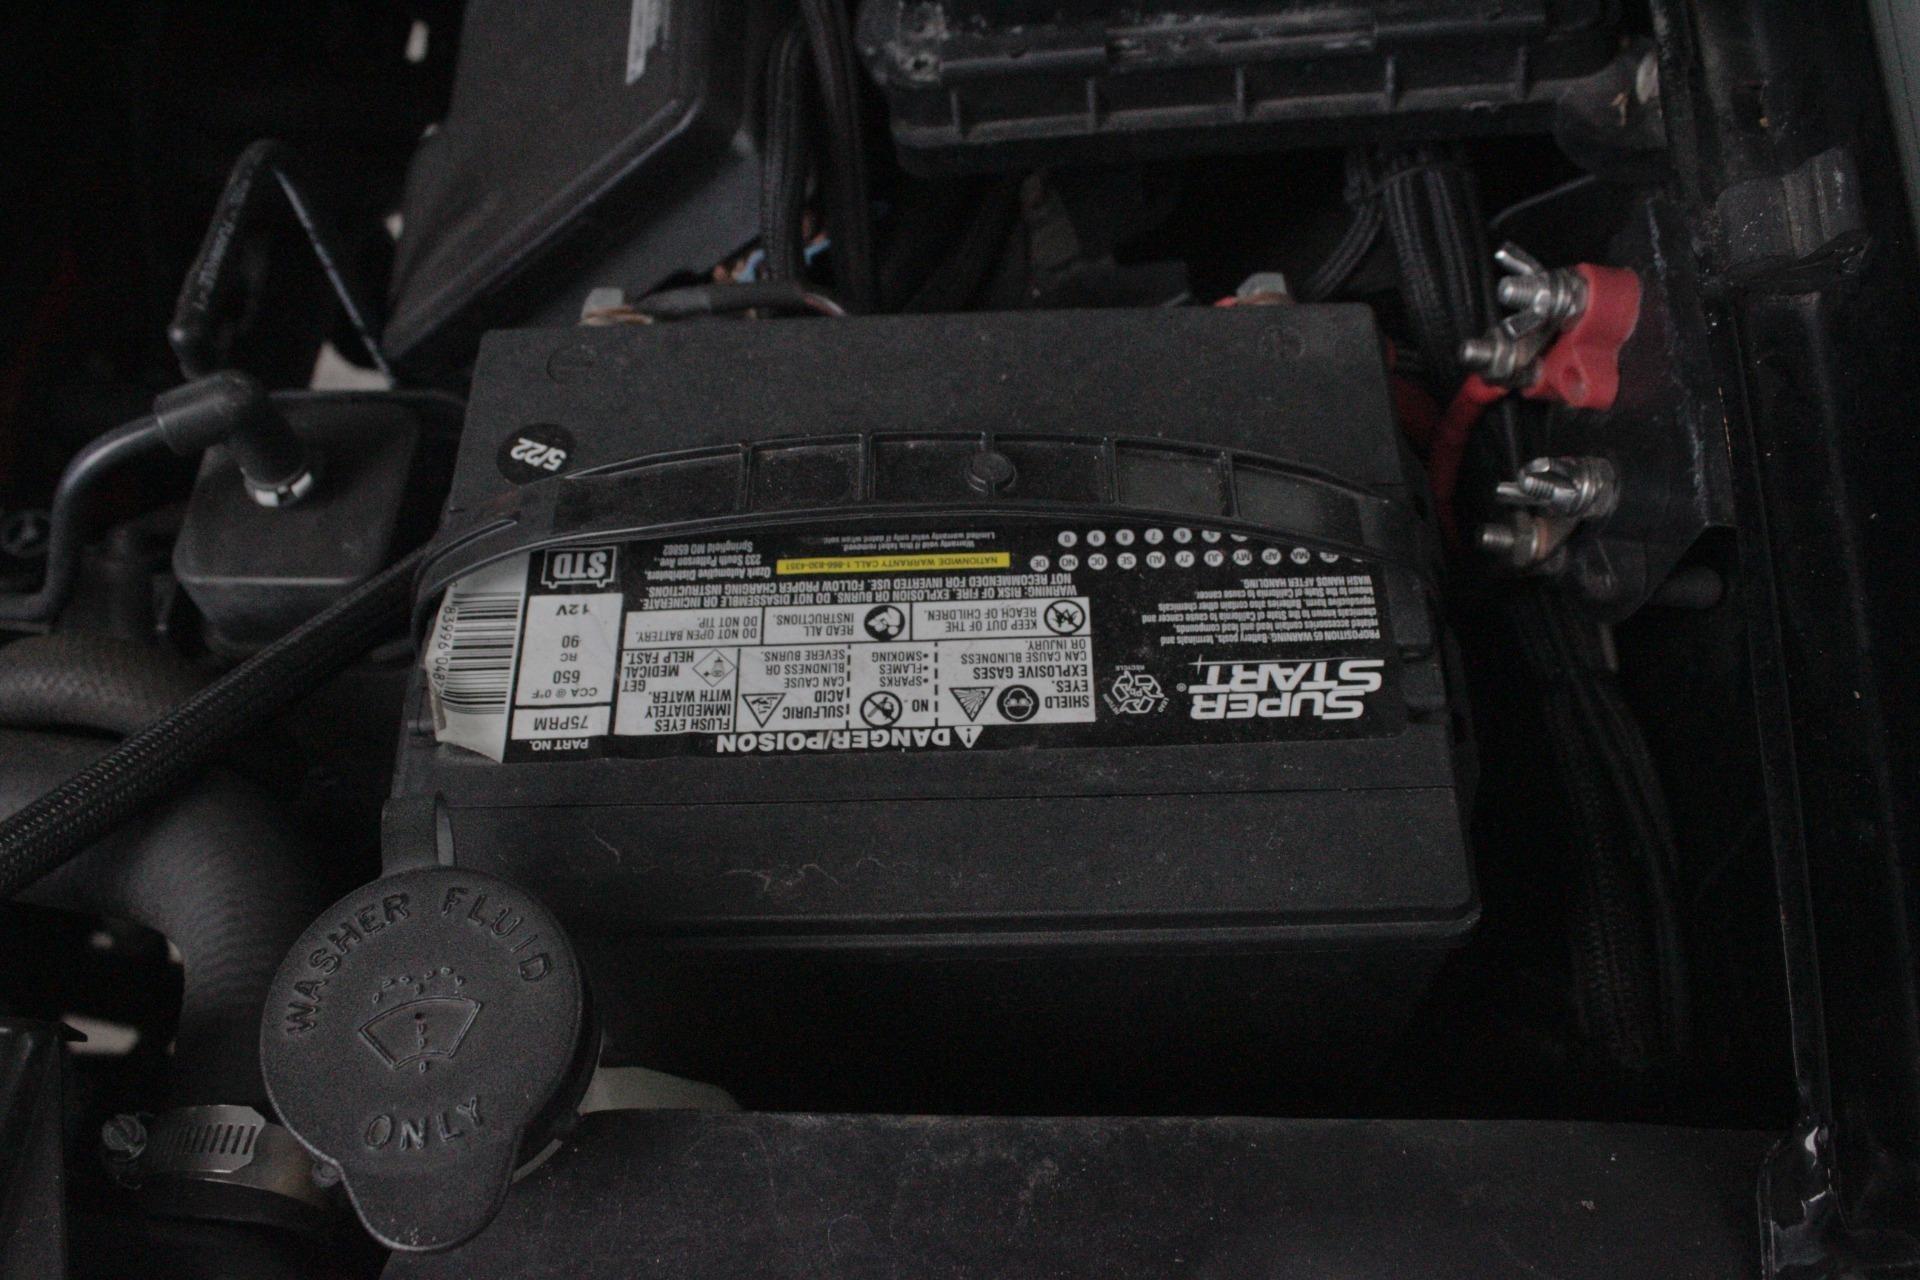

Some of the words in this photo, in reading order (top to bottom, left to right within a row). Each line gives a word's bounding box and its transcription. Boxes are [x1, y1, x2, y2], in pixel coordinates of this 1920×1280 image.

[510, 437, 567, 471] 5/22
[690, 544, 705, 554] MO
[707, 540, 753, 554] Springfield
[553, 552, 607, 579] STD
[677, 556, 717, 568] Patterson
[719, 554, 744, 567] South
[854, 560, 879, 568] CALL
[881, 558, 935, 567] WARRANTY
[938, 556, 998, 566] NATIONWIDE
[698, 567, 746, 579] Automotive
[1050, 573, 1072, 585] NOT
[779, 580, 820, 593] PROPER
[822, 580, 864, 592] FOLLOW
[867, 578, 891, 590] USE.
[894, 577, 943, 590] INVERTED
[945, 576, 966, 587] FOR
[969, 574, 1048, 587] RECOMMENDED
[645, 584, 722, 598] INSTRUCTIONS.
[724, 582, 777, 595] CHARGING
[981, 587, 995, 599] OF
[997, 586, 1022, 598] RISK
[1024, 584, 1077, 598] WARNING:
[720, 594, 790, 607] DISASSEMBLE
[794, 593, 814, 605] NOT
[816, 592, 831, 604] DO
[834, 592, 872, 604] BURNS.
[875, 591, 890, 602] OR
[892, 588, 950, 602] EXPLOSION
[640, 597, 701, 610] INCINERATE.
[703, 596, 718, 608] OR
[556, 604, 590, 616] 12V
[924, 608, 981, 621] CHILDREN.
[984, 608, 998, 619] OF
[1002, 606, 1036, 618] REACH
[697, 617, 715, 629] TIP.
[718, 616, 740, 628] NOT
[743, 616, 758, 628] DO
[772, 612, 854, 625] INSTRUCTIONS.
[1011, 618, 1037, 630] KEEP
[437, 606, 456, 650] 83996
[803, 626, 822, 636] ALL
[826, 625, 854, 636] READ
[945, 621, 965, 632] THE
[968, 620, 982, 631] OF
[985, 620, 1008, 631] OUT
[635, 630, 683, 642] BATTERY.
[688, 629, 714, 640] OPEN
[717, 628, 738, 639] NOT
[742, 627, 757, 638] DO
[1240, 631, 1267, 643] Battery
[1324, 628, 1380, 640] PROPOSITION
[562, 635, 580, 648] 90
[1025, 640, 1066, 652] INJURY.
[1071, 639, 1086, 650] OR
[1160, 636, 1175, 646] and
[1176, 635, 1214, 645] terminals
[560, 652, 577, 662] RC
[626, 652, 659, 665] FAST.
[663, 651, 694, 663] HELP
[760, 650, 801, 661] BURNS.
[804, 649, 845, 659] SEVERE
[871, 651, 922, 662] SMOKING
[960, 653, 1022, 665] BLINDNESS
[1026, 652, 1061, 663] CAUSE
[1065, 651, 1086, 662] CAN
[624, 665, 679, 677] MEDICAL
[766, 664, 780, 674] OR
[784, 663, 845, 674] BLINDNESS
[879, 663, 922, 674] FLAMES
[973, 666, 1013, 680] GASES
[1019, 664, 1087, 678] EXPLOSIVE
[552, 670, 581, 684] 650
[823, 676, 844, 687] CAN
[879, 676, 922, 686] SPARKS
[1188, 659, 1384, 694] START
[622, 680, 646, 692] GET
[784, 678, 819, 688] CAUSE
[1052, 680, 1088, 692] EYES.
[571, 687, 598, 696] CCA
[648, 690, 694, 704] WATER.
[700, 689, 731, 702] WITH
[814, 690, 844, 703] ACID
[912, 698, 928, 712] NO
[1044, 696, 1089, 708] SHIELD
[1190, 689, 1366, 720] SUPER
[644, 704, 730, 718] IMMEDIATELY
[782, 705, 844, 720] SULFURIC
[533, 715, 589, 730] 75PRM
[655, 719, 686, 732] EYES
[691, 718, 730, 731] FLUSH
[529, 740, 552, 751] NO.
[554, 738, 589, 750] PART
[717, 728, 950, 752] DANGER/POISON
[285, 893, 411, 1036] WASHER
[442, 887, 553, 982] FLUID
[364, 1096, 481, 1151] ONLY
